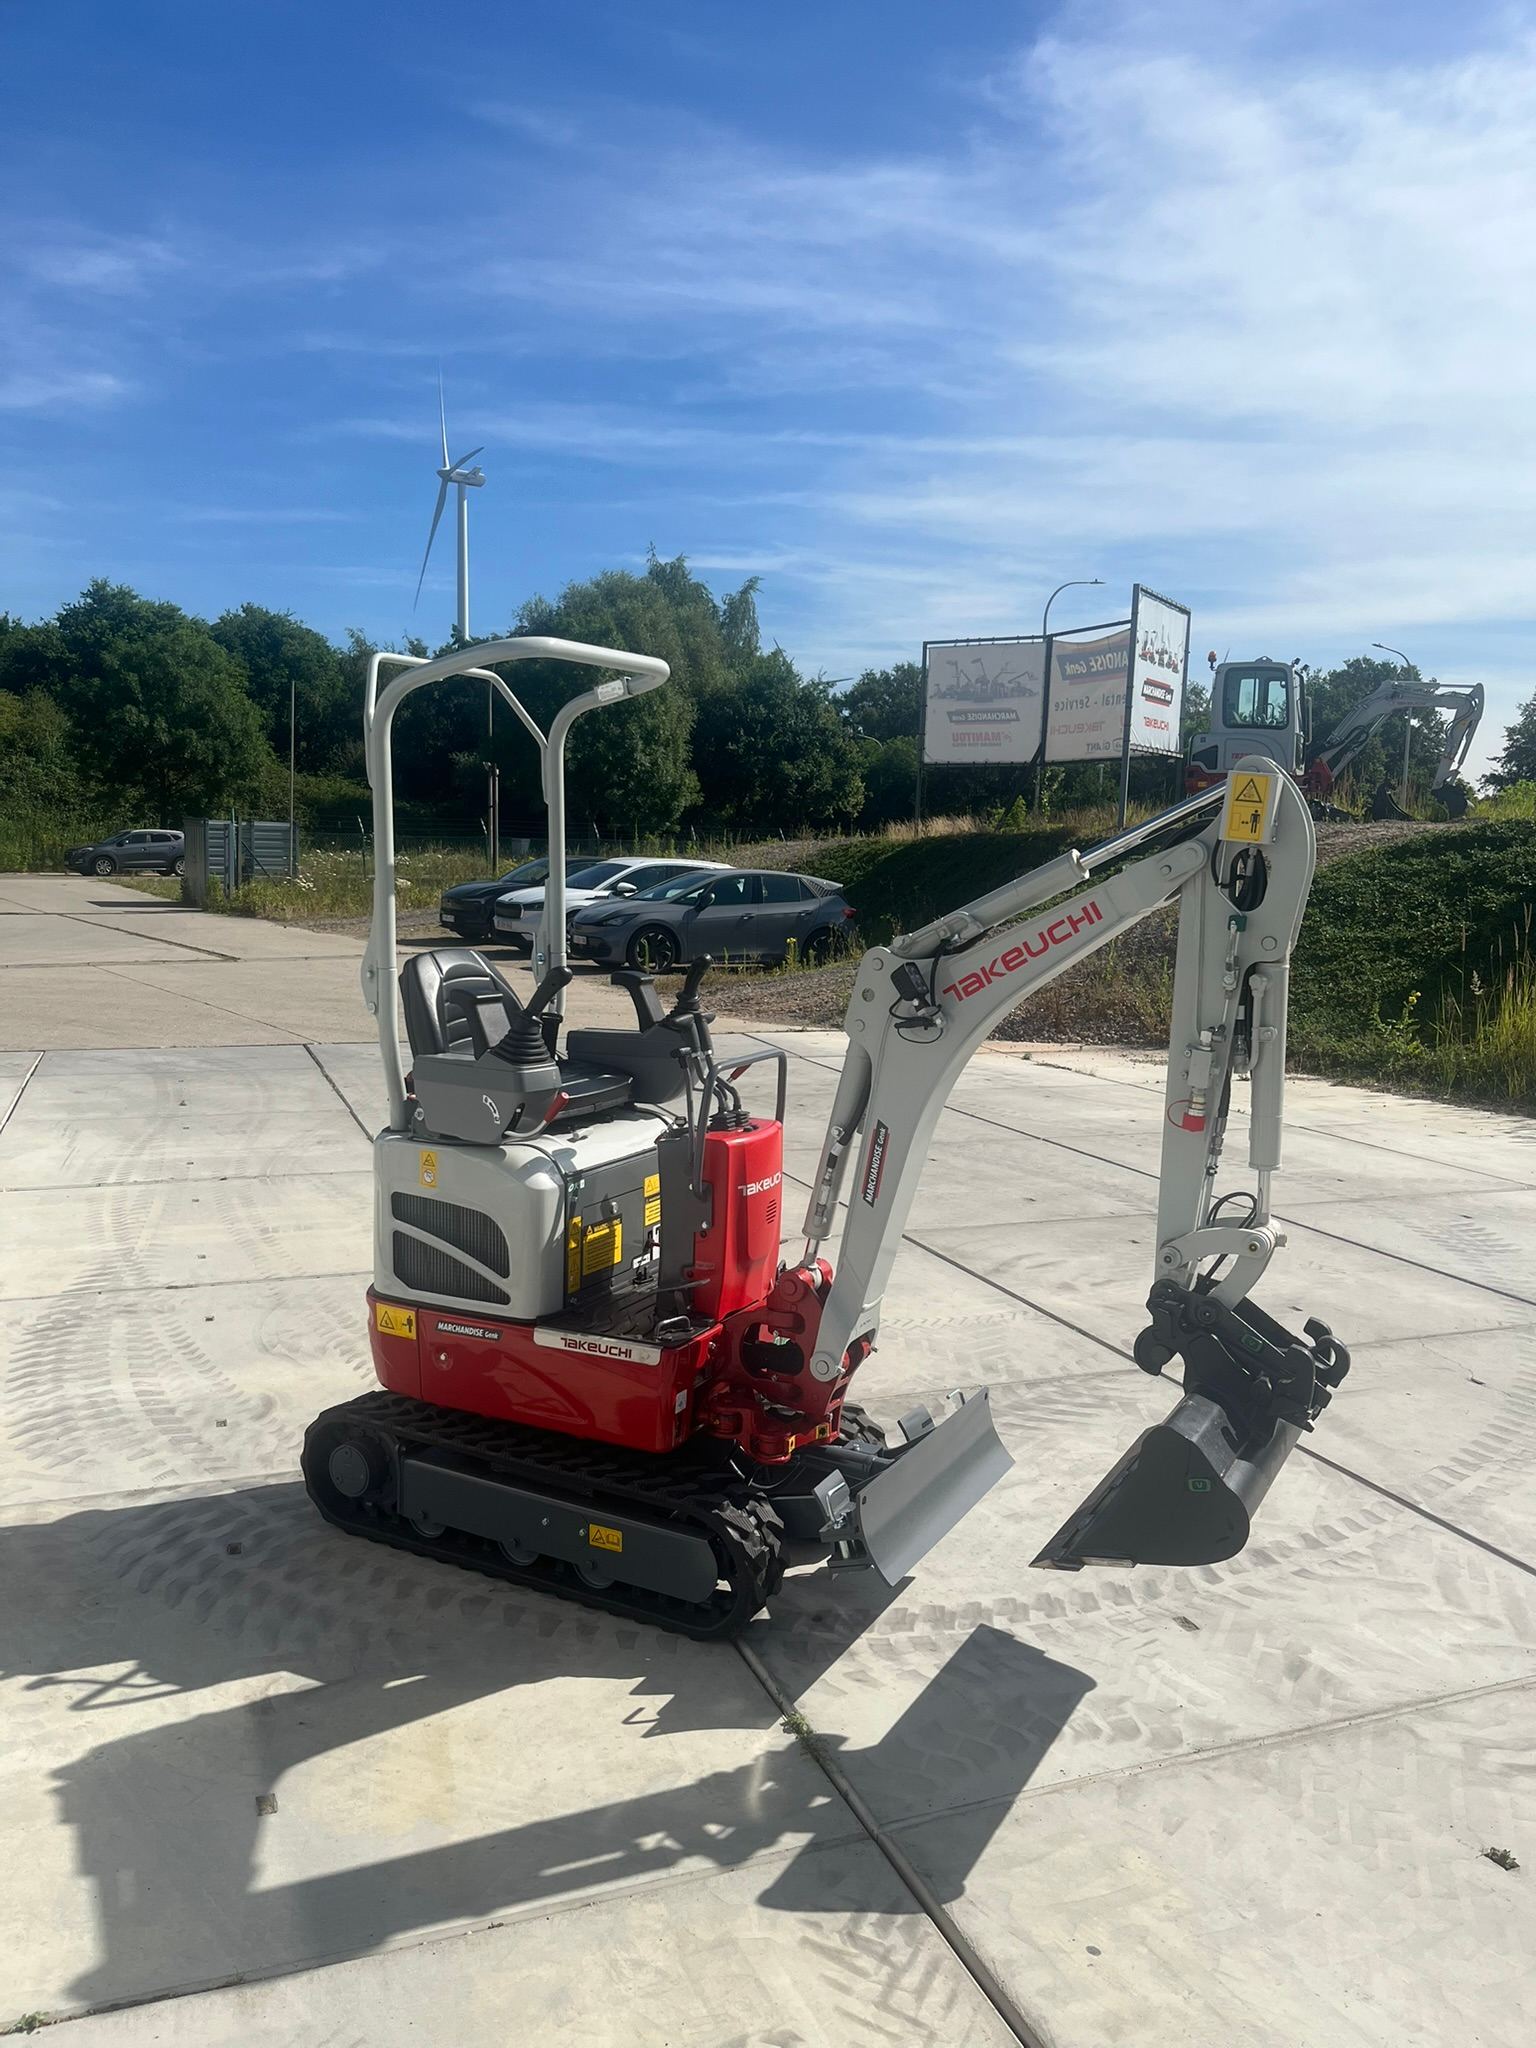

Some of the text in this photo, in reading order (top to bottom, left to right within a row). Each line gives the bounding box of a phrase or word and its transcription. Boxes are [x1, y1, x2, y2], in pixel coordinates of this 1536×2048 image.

[865, 1144, 883, 1203] MARCHANDISE
[437, 1321, 499, 1340] MARCHANDISE Genk
